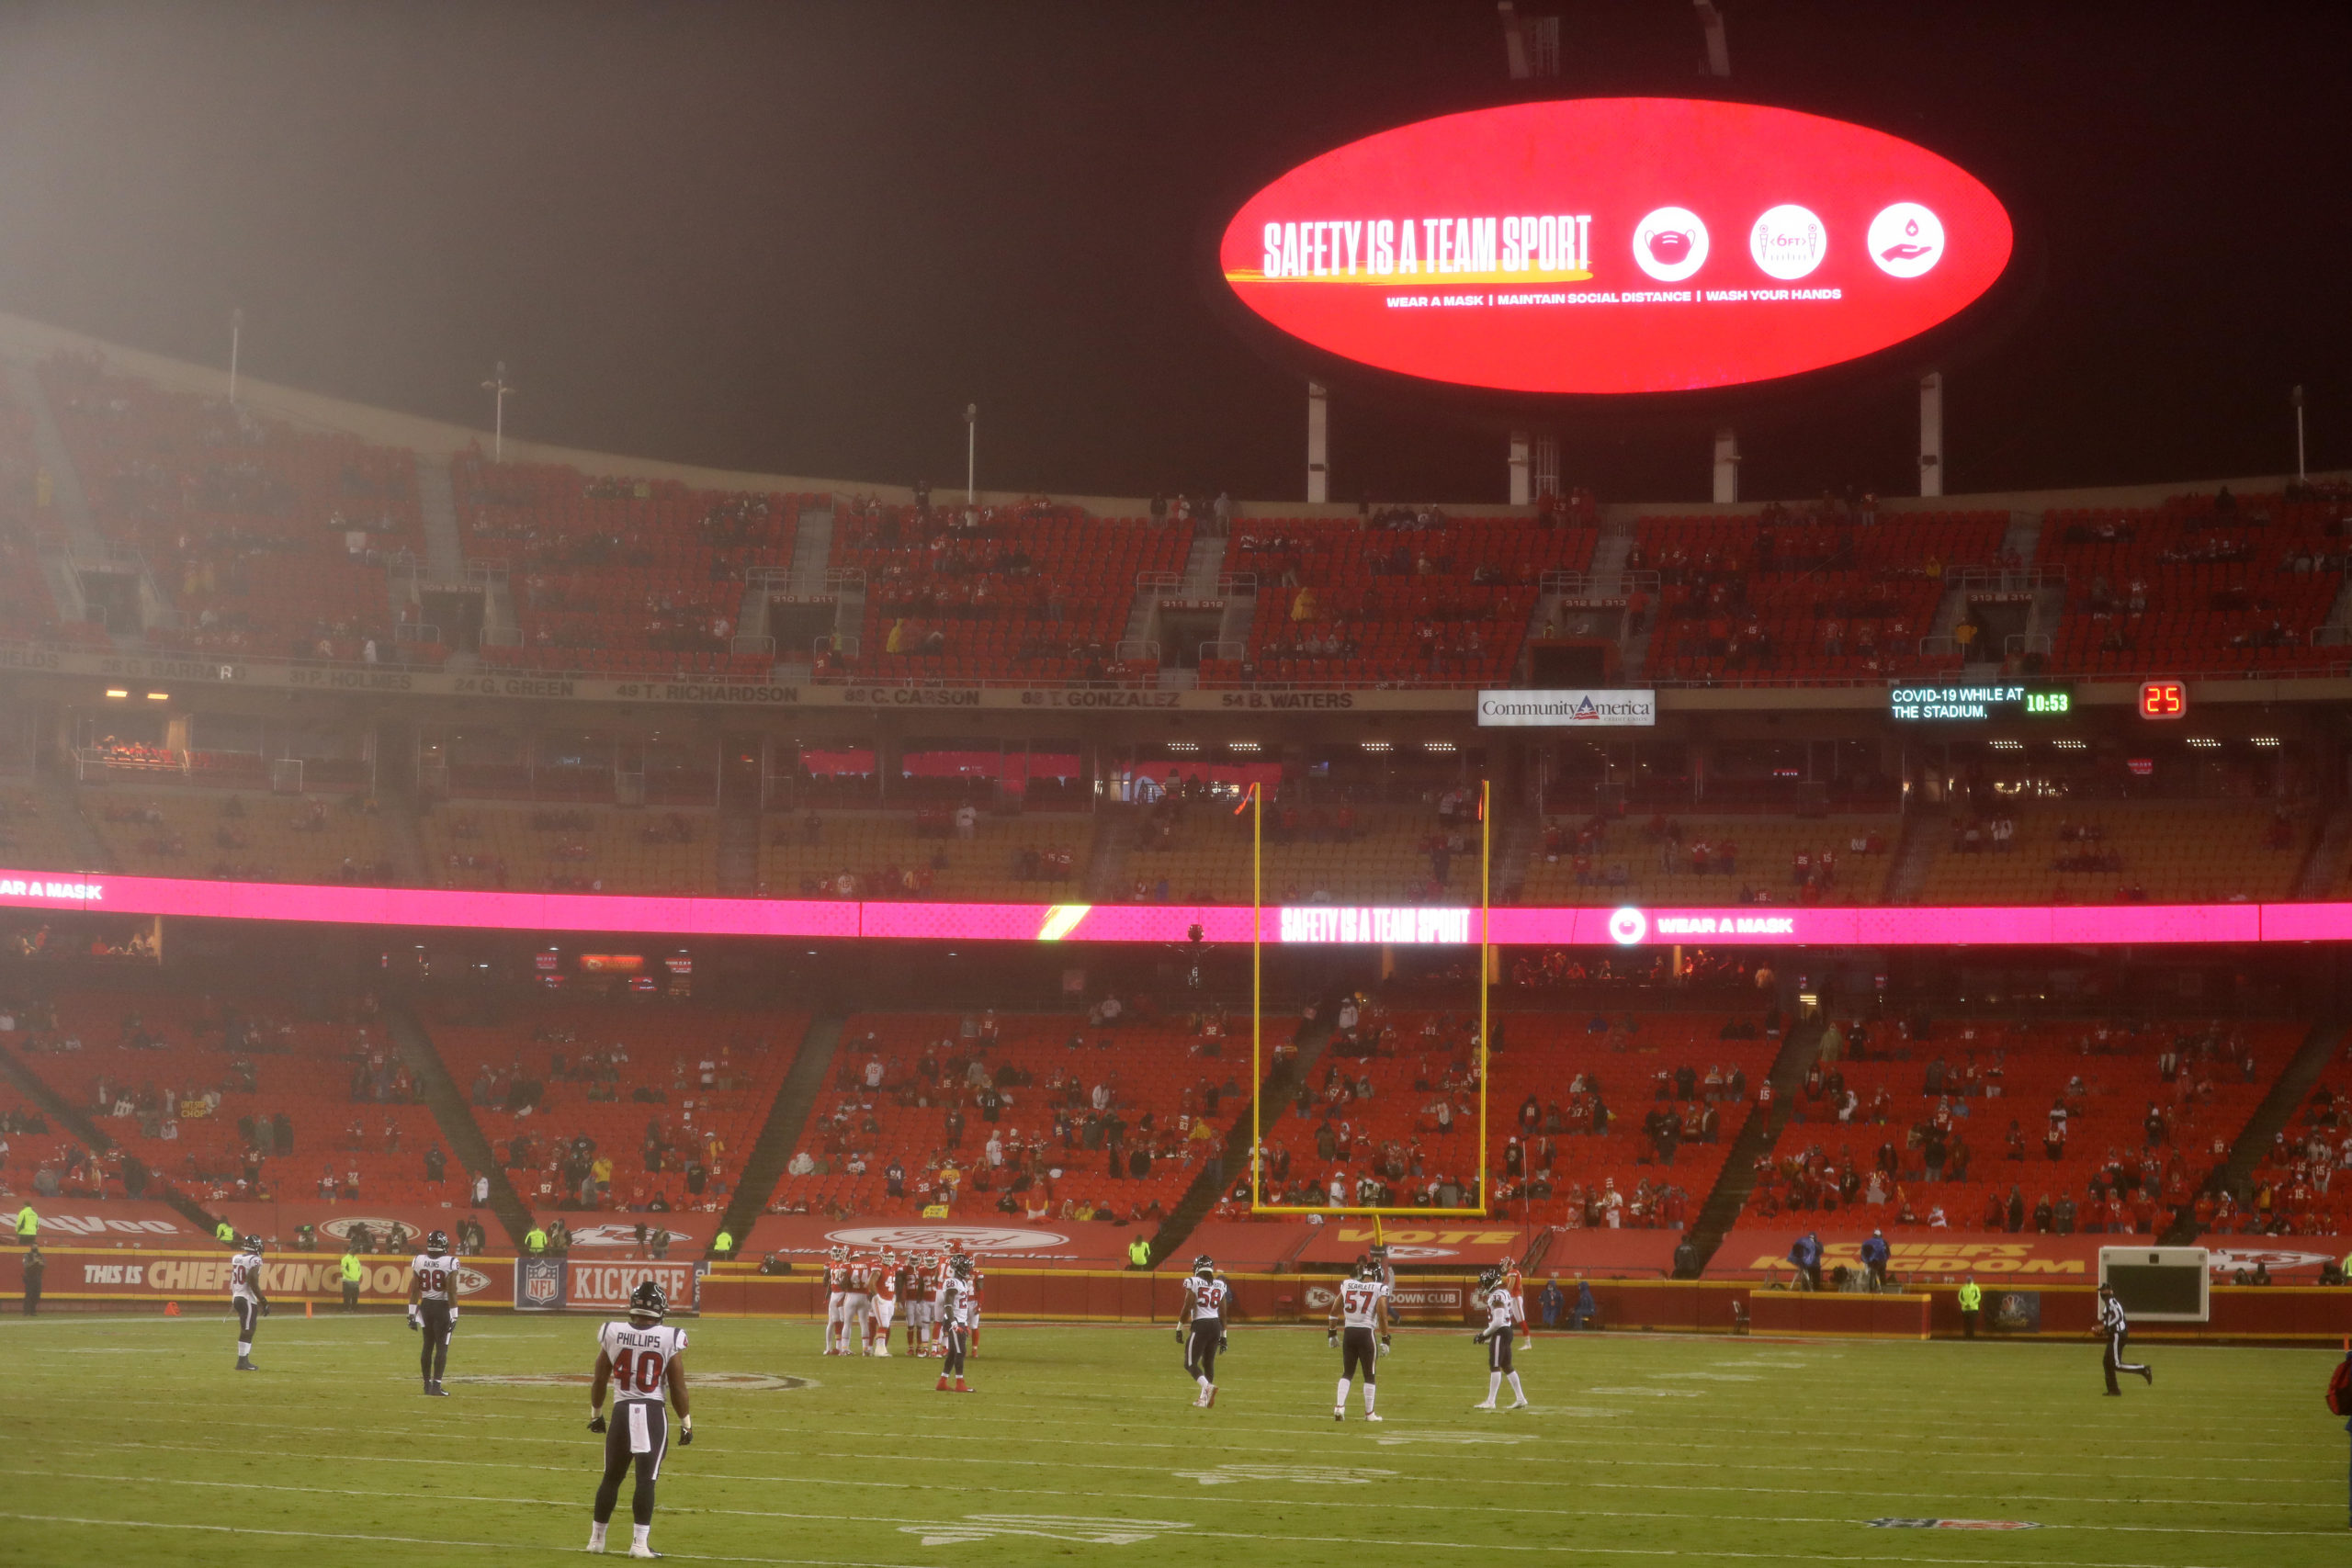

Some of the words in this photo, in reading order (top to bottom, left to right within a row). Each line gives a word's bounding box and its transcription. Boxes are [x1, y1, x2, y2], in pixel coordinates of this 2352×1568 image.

[1264, 220, 1362, 277] SAFETY
[1367, 220, 1394, 275] IS
[1399, 220, 1417, 274] A
[1423, 218, 1496, 273] TEAM
[1503, 215, 1591, 271] SPORT
[1777, 232, 1799, 247] 6FT
[1386, 296, 1428, 308] WEAR
[1430, 296, 1441, 307] A
[1443, 295, 1483, 307] MASK
[1498, 293, 1565, 305] MAINTAIN
[1568, 292, 1620, 304] SOCIAL
[1622, 291, 1691, 303] DISTANCE
[1706, 290, 1747, 301] WASH
[1750, 289, 1789, 300] YOUR
[1792, 288, 1842, 299] HANDS
[331, 671, 412, 690] HOLMES
[480, 680, 501, 694] G.
[505, 681, 574, 696] GREEN
[616, 684, 638, 696] 49
[645, 684, 662, 699] T.
[666, 684, 797, 703] RICHARDSON
[871, 689, 889, 705] C.
[894, 689, 980, 706] CARSON
[1052, 691, 1065, 706] T.
[1067, 691, 1182, 708] GONZALEZ
[1222, 694, 1244, 706] 54
[1249, 693, 1268, 708] B.
[1271, 693, 1353, 709] WATERS
[1892, 690, 1956, 704] COVID-19
[1960, 689, 2004, 702] WHILE
[2007, 688, 2024, 701] AT
[2147, 686, 2180, 713] 25
[1482, 694, 1650, 720] CommunityAmerica
[2027, 694, 2069, 713] 10:53
[1892, 705, 1918, 719] THE
[1924, 705, 1988, 721] STADIUM,
[28, 882, 44, 897] A
[46, 883, 102, 899] MASK
[1281, 908, 1339, 942] SAFETY
[1340, 908, 1357, 942] IS
[1359, 908, 1371, 942] A
[1373, 908, 1416, 942] TEAM
[1418, 908, 1470, 942] SPORT
[1657, 919, 1716, 933] WEAR
[1719, 919, 1734, 933] A
[1737, 919, 1793, 933] MASK
[871, 1231, 1021, 1247] Ford
[1338, 1229, 1521, 1245] VOTE
[1749, 1257, 2085, 1273] KNGDOM
[84, 1264, 123, 1284] THIS
[124, 1264, 142, 1284] IS
[147, 1260, 232, 1291] CHIEF
[419, 1269, 446, 1292] 88
[529, 1279, 554, 1298] NFL
[1197, 1287, 1221, 1309] 58
[1344, 1290, 1374, 1314] 57
[1428, 1293, 1456, 1303] CLUB
[616, 1332, 661, 1348] PHILLIPS
[613, 1348, 664, 1393] 40
